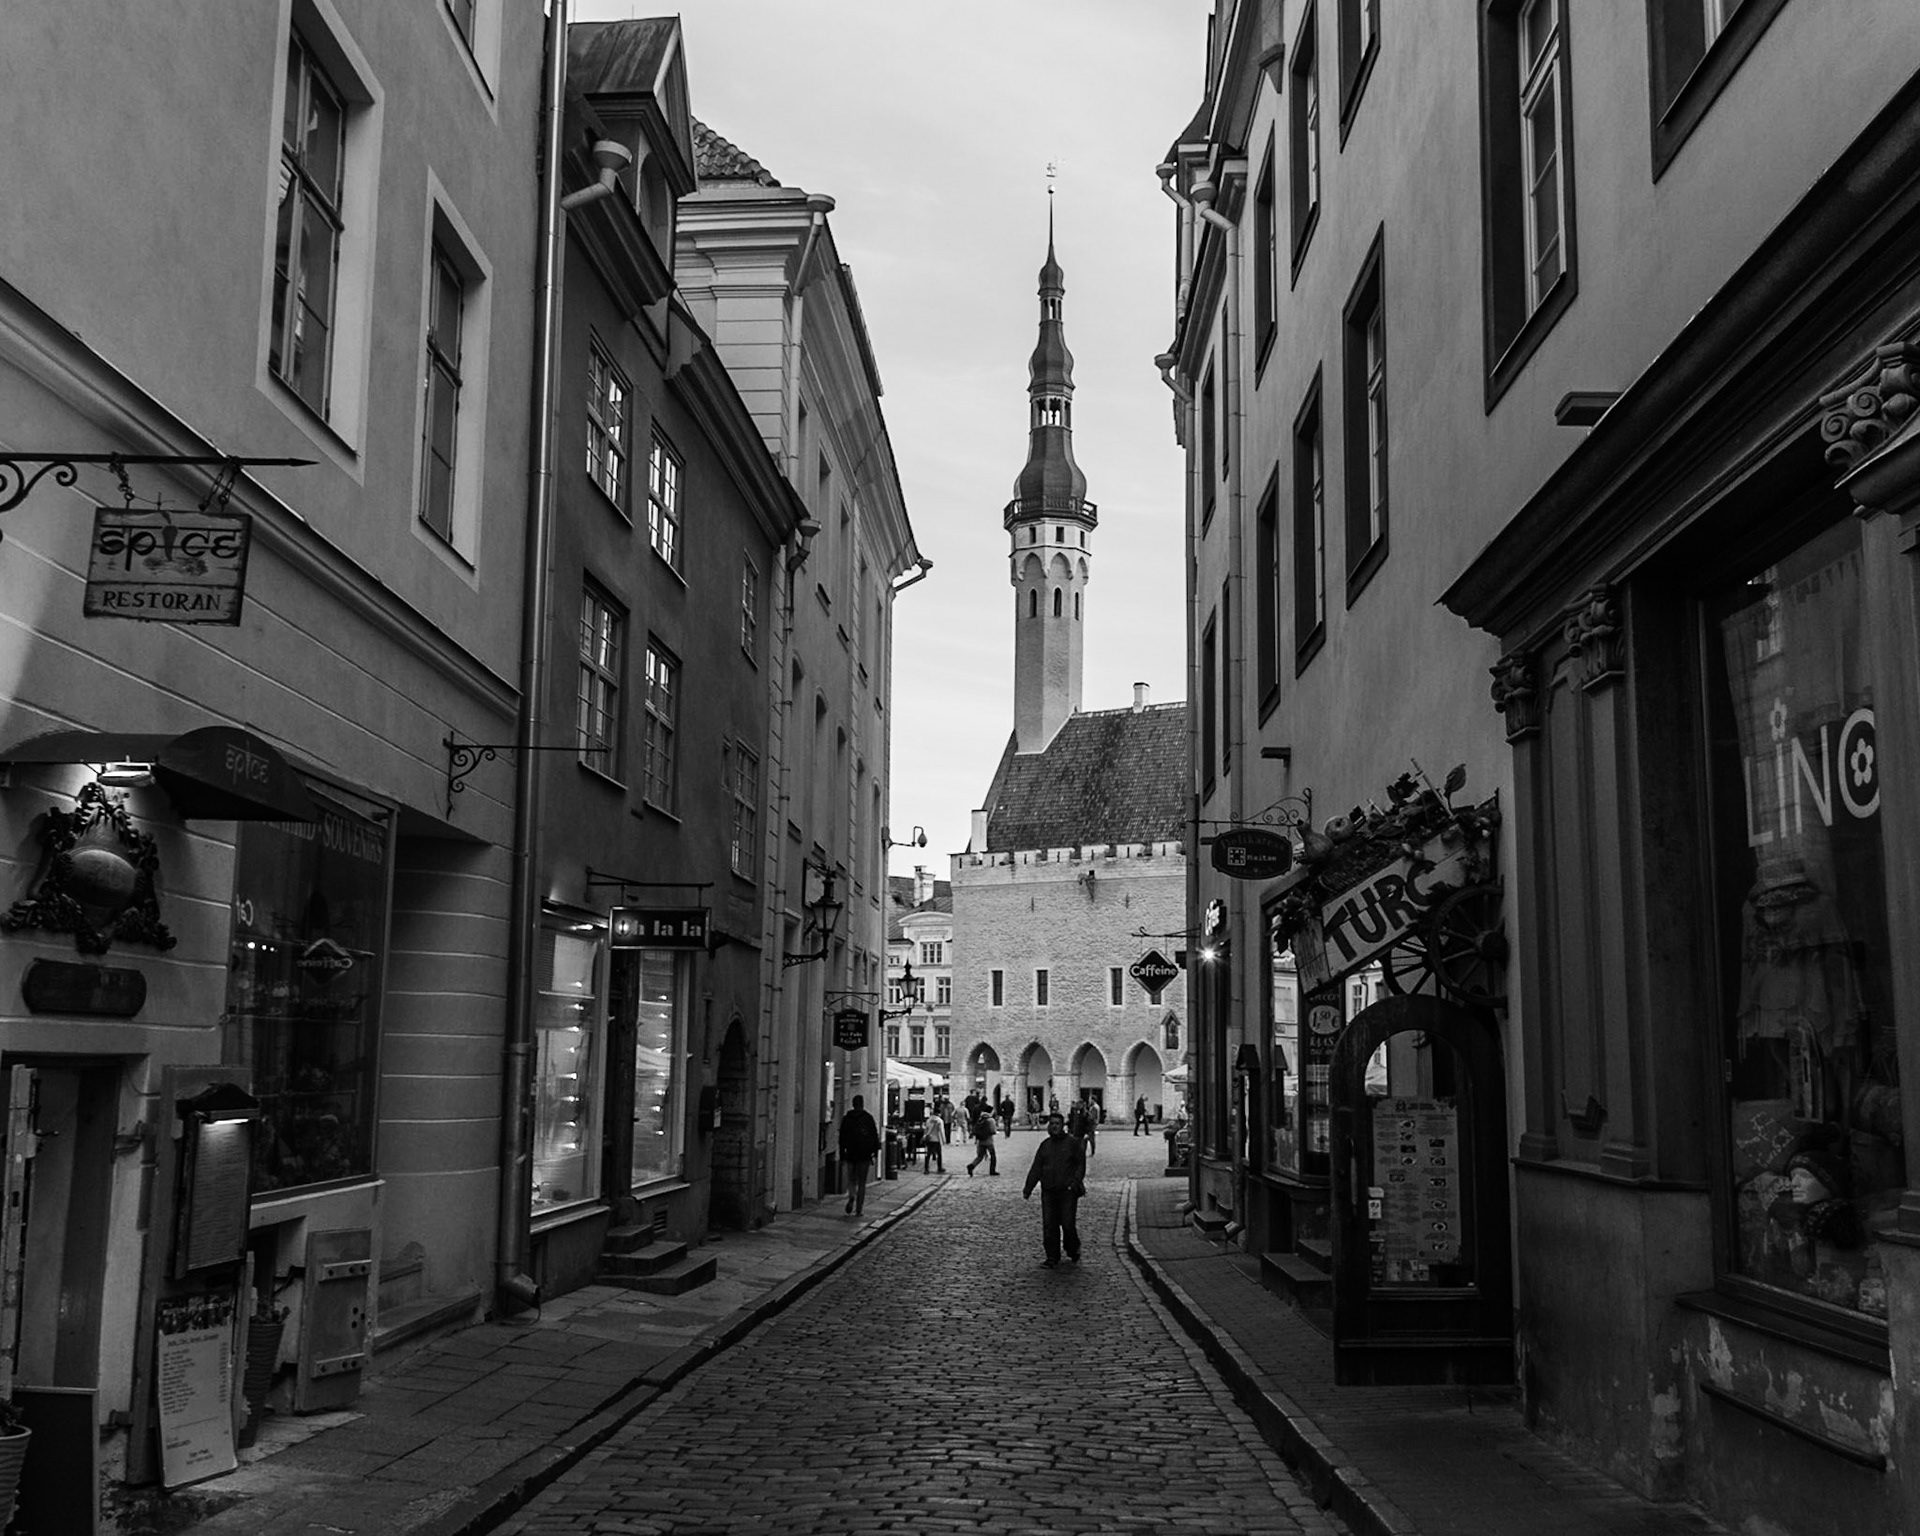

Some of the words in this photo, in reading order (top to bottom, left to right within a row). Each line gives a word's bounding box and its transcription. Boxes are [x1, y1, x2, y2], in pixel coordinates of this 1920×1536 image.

[102, 590, 222, 612] RESTORAN
[614, 920, 645, 936] Oh
[653, 920, 674, 936] la
[681, 920, 702, 937] la
[1130, 964, 1177, 977] Caffeine
